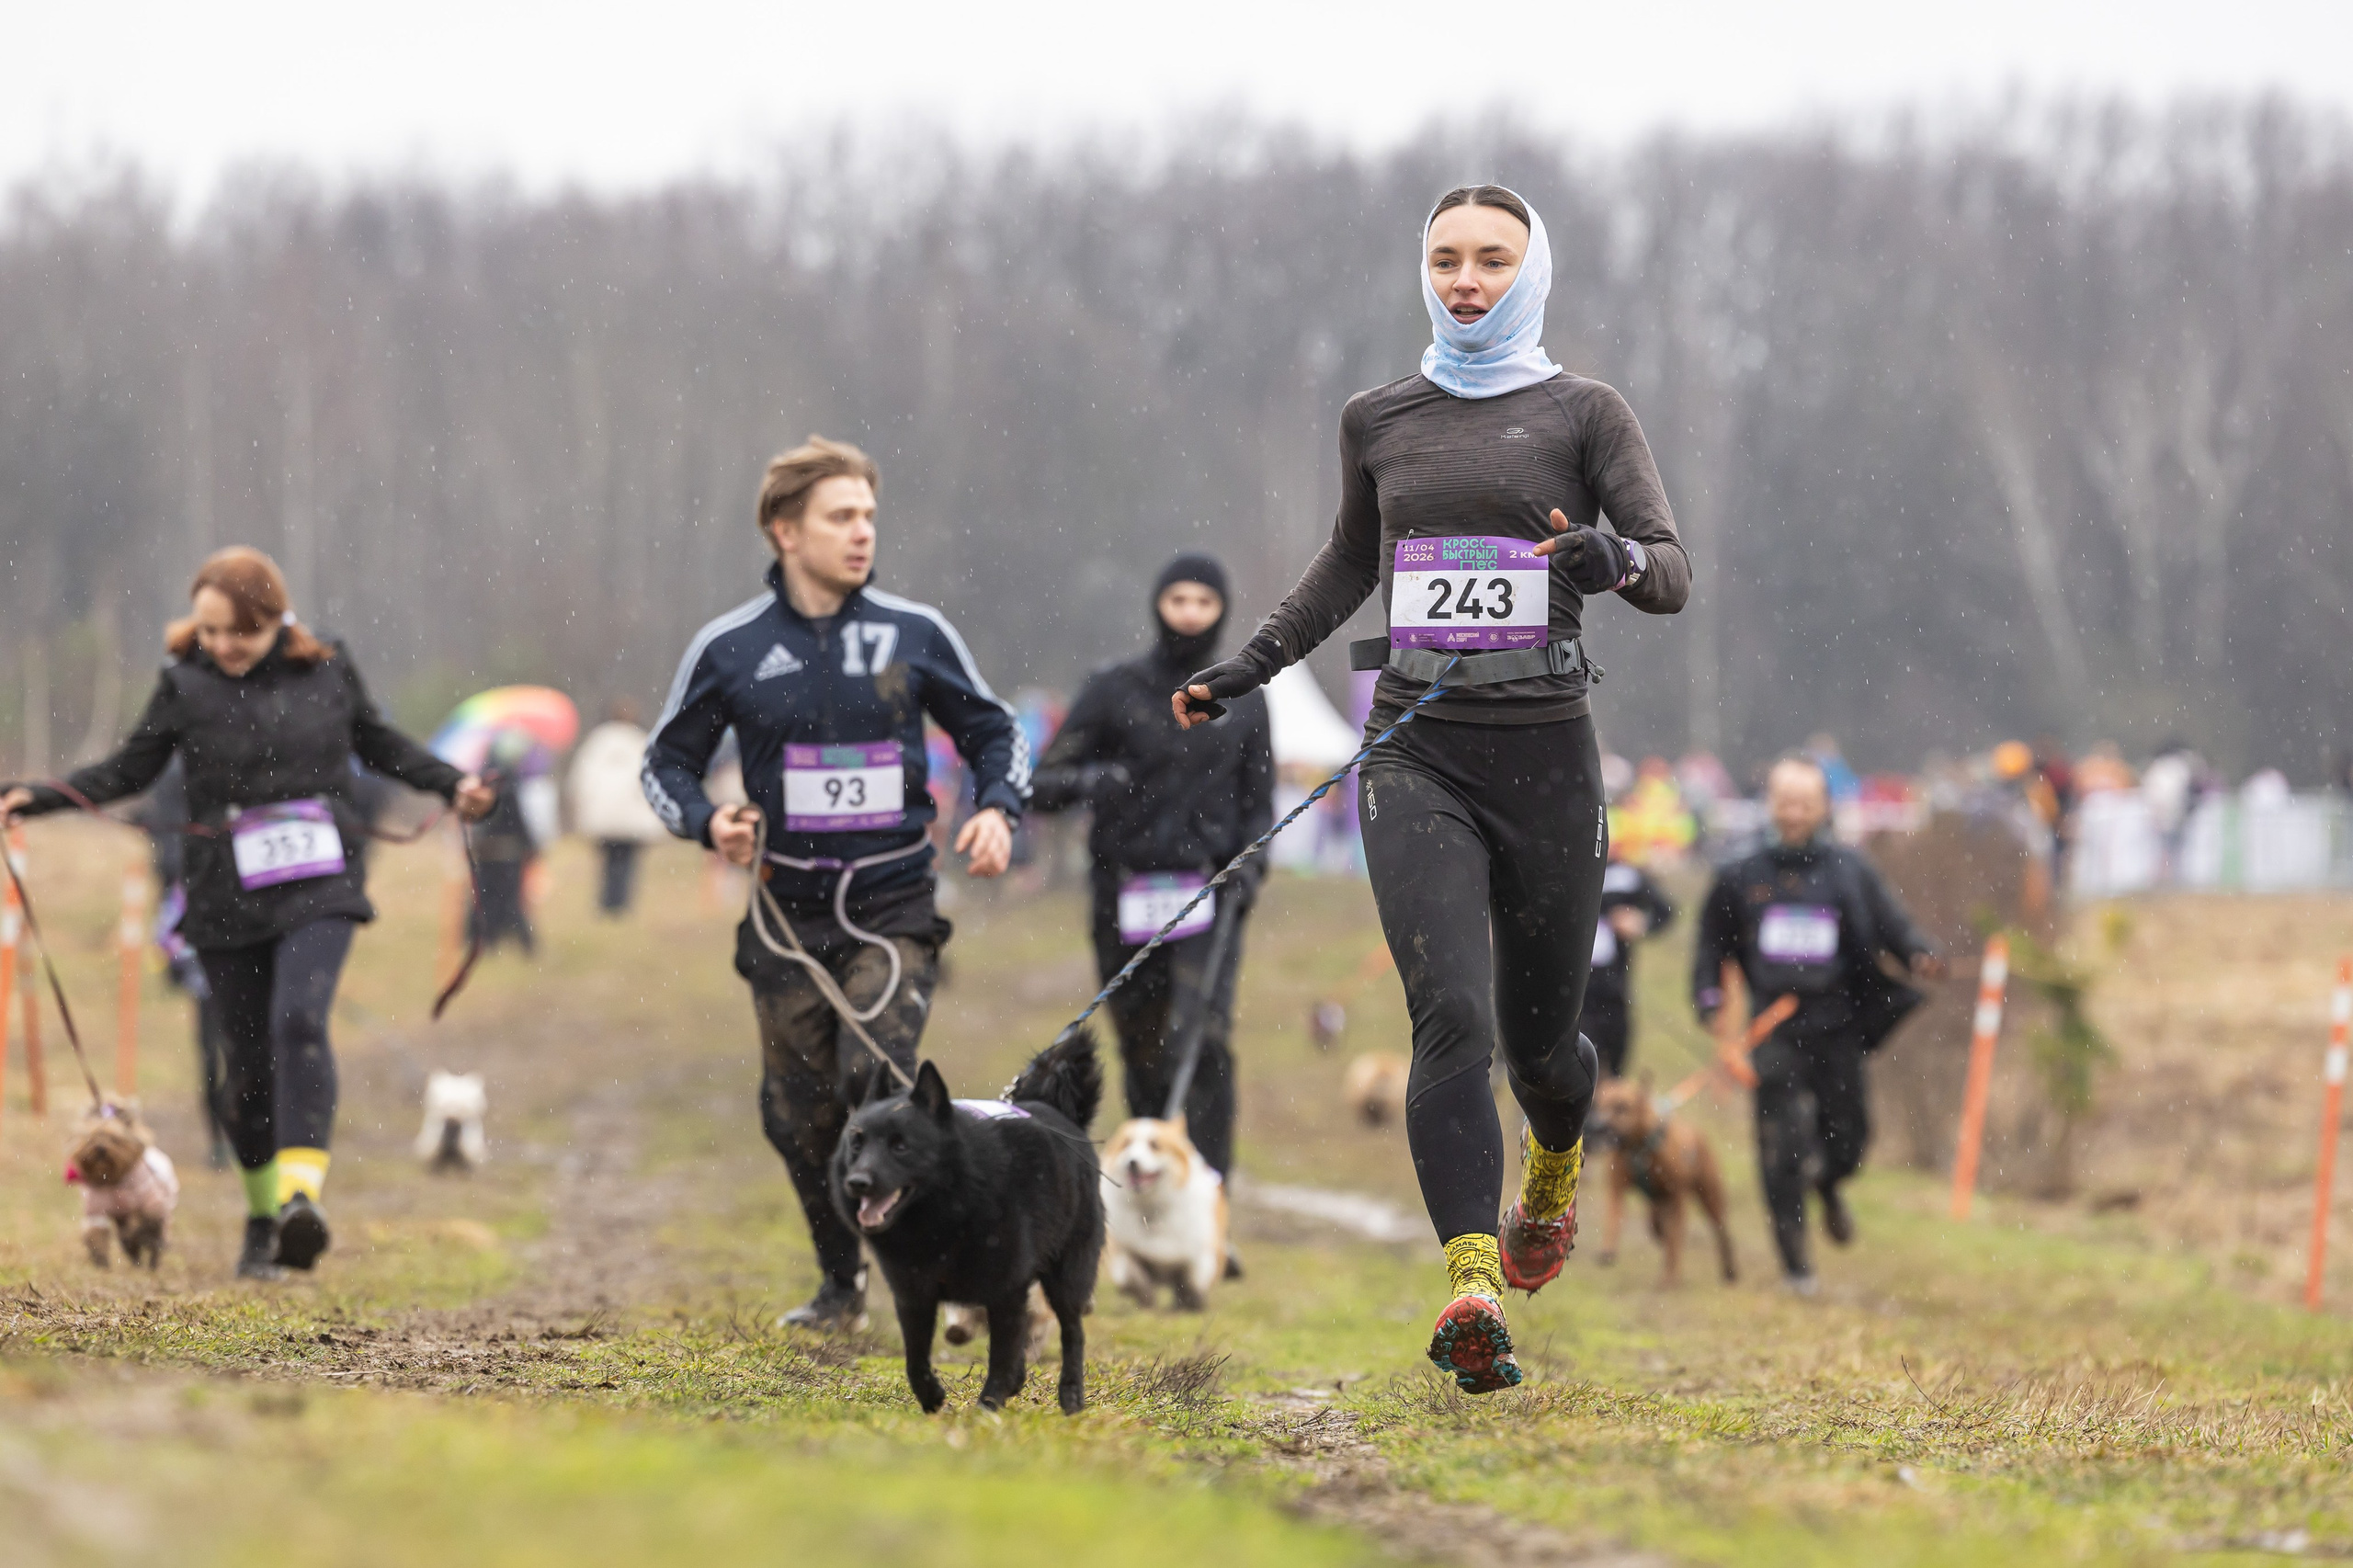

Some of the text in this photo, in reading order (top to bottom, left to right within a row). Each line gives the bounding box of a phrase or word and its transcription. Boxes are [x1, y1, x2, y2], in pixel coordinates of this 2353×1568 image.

[1443, 539, 1486, 549] КРОСС
[1404, 553, 1434, 562] 2026
[1509, 550, 1518, 559] 2
[1427, 577, 1514, 619] 243
[839, 619, 900, 677] 17
[824, 777, 867, 808] 93
